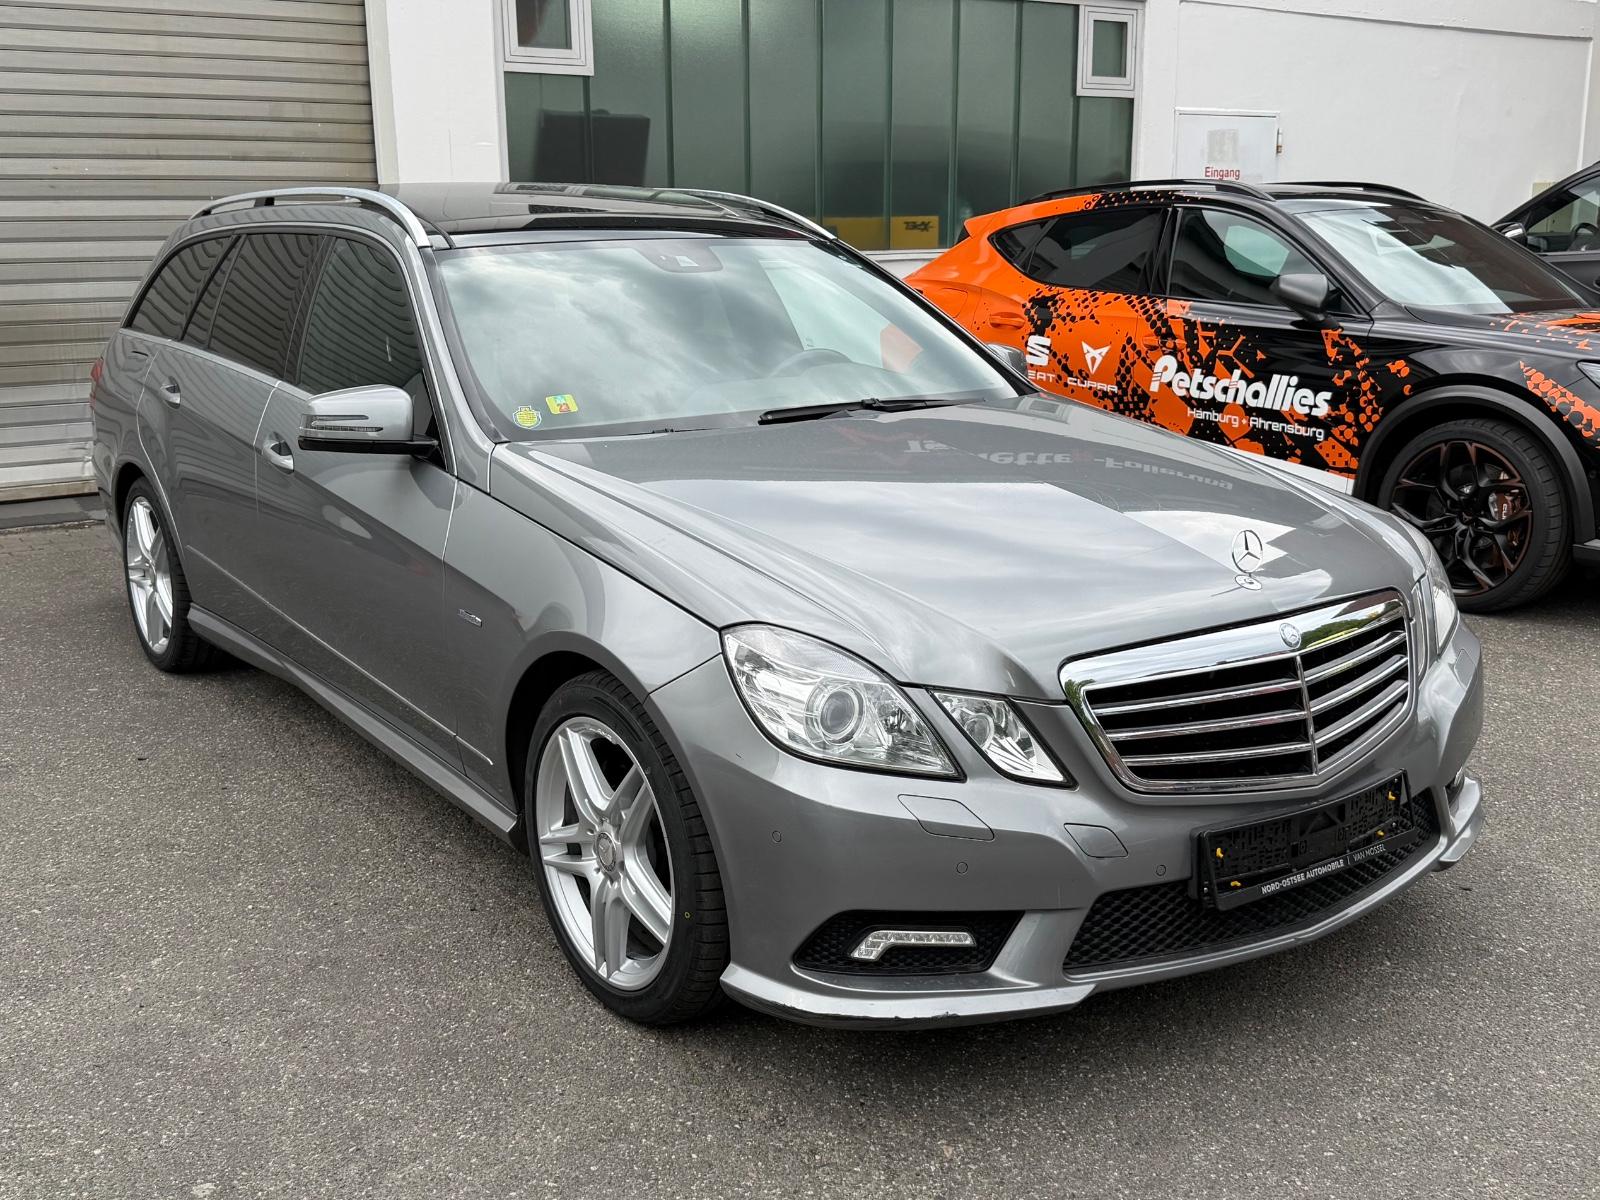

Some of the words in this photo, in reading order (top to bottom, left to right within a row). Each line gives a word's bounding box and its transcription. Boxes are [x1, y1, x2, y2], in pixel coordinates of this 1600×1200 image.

[1204, 166, 1241, 180] Eingang
[1027, 369, 1056, 383] EAT
[1066, 377, 1119, 394] CUPRA
[1150, 354, 1333, 417] Petschallies
[1186, 407, 1240, 428] Hamburg
[1249, 416, 1325, 442] Ahrensburg
[1260, 872, 1306, 895] NORD-OSTSEE
[1305, 859, 1345, 880] AUTOMOBILE
[1352, 851, 1365, 862] VAN
